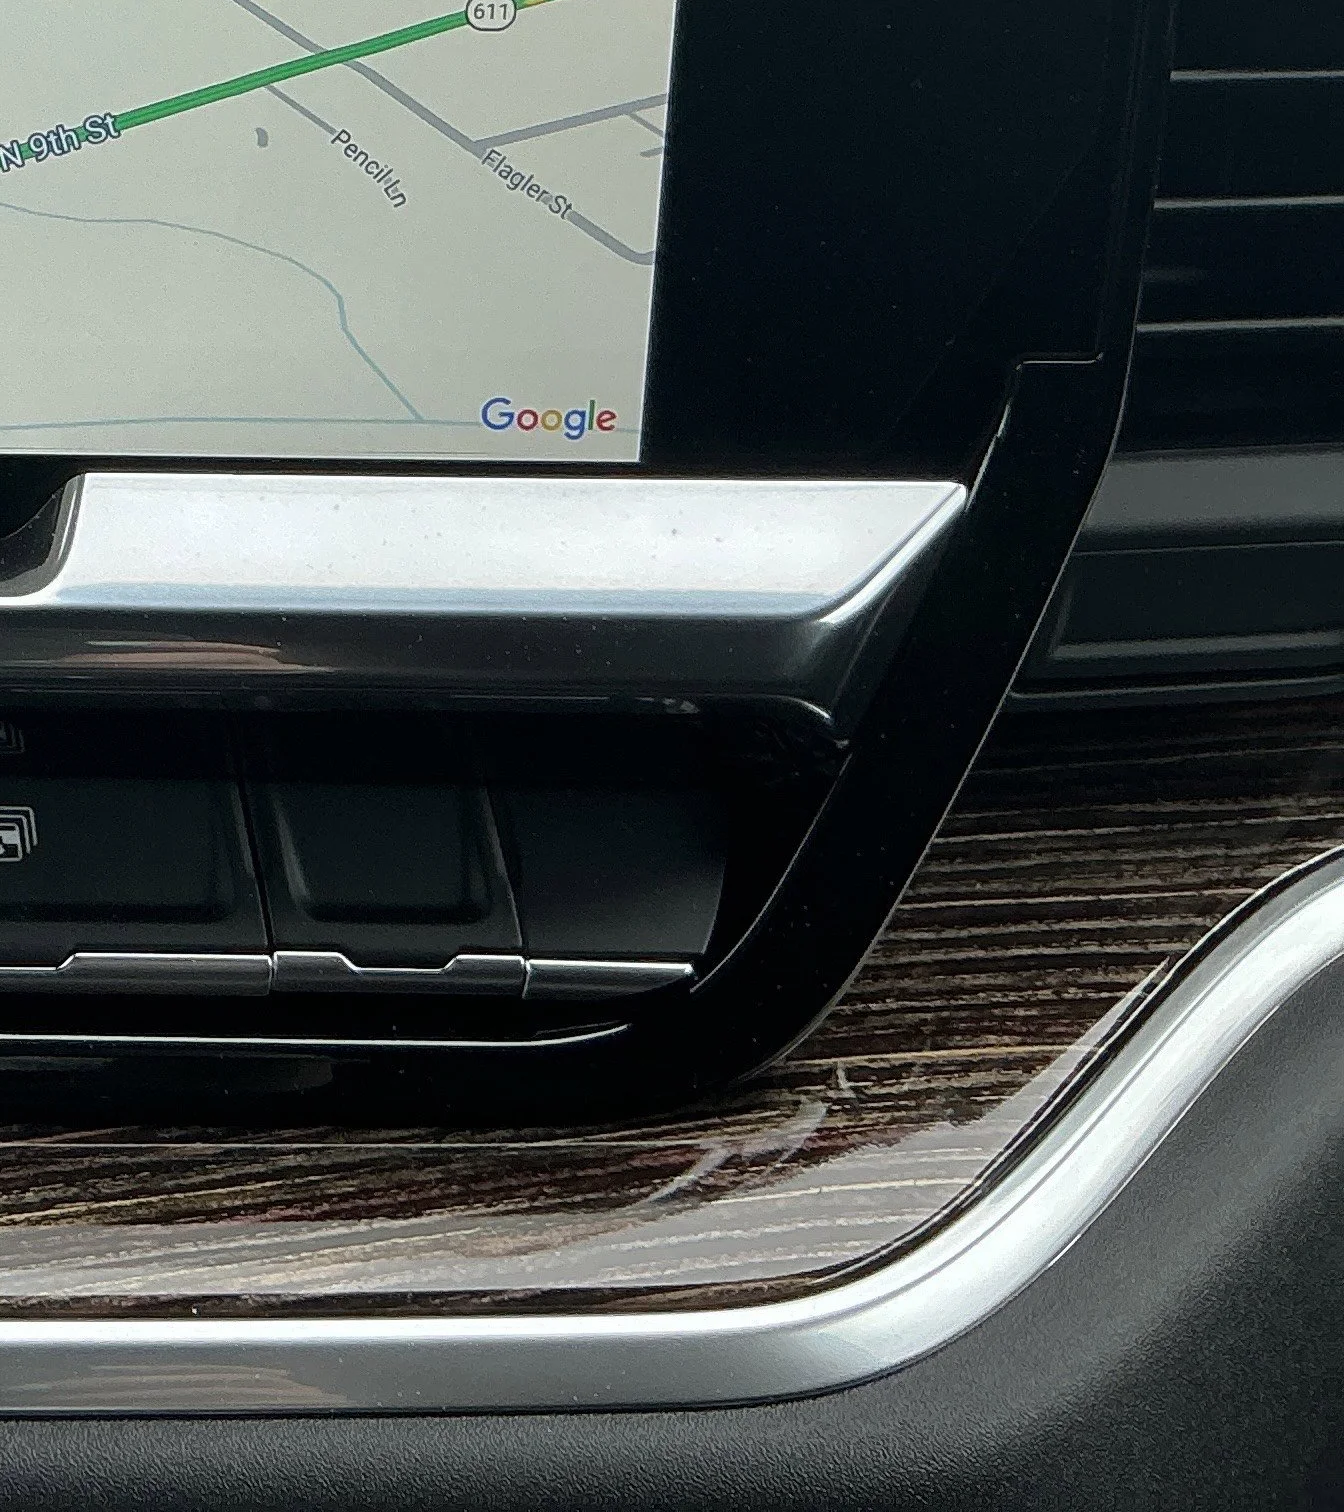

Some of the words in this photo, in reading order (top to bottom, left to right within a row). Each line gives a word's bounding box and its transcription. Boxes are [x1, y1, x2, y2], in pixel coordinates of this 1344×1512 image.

[473, 2, 510, 21] 611
[29, 124, 78, 162] 9th
[83, 113, 119, 145] St
[331, 129, 390, 184] Pencil
[383, 179, 408, 209] Ln
[481, 149, 547, 202] Flagler
[546, 191, 573, 220] St
[481, 396, 618, 440] Google
